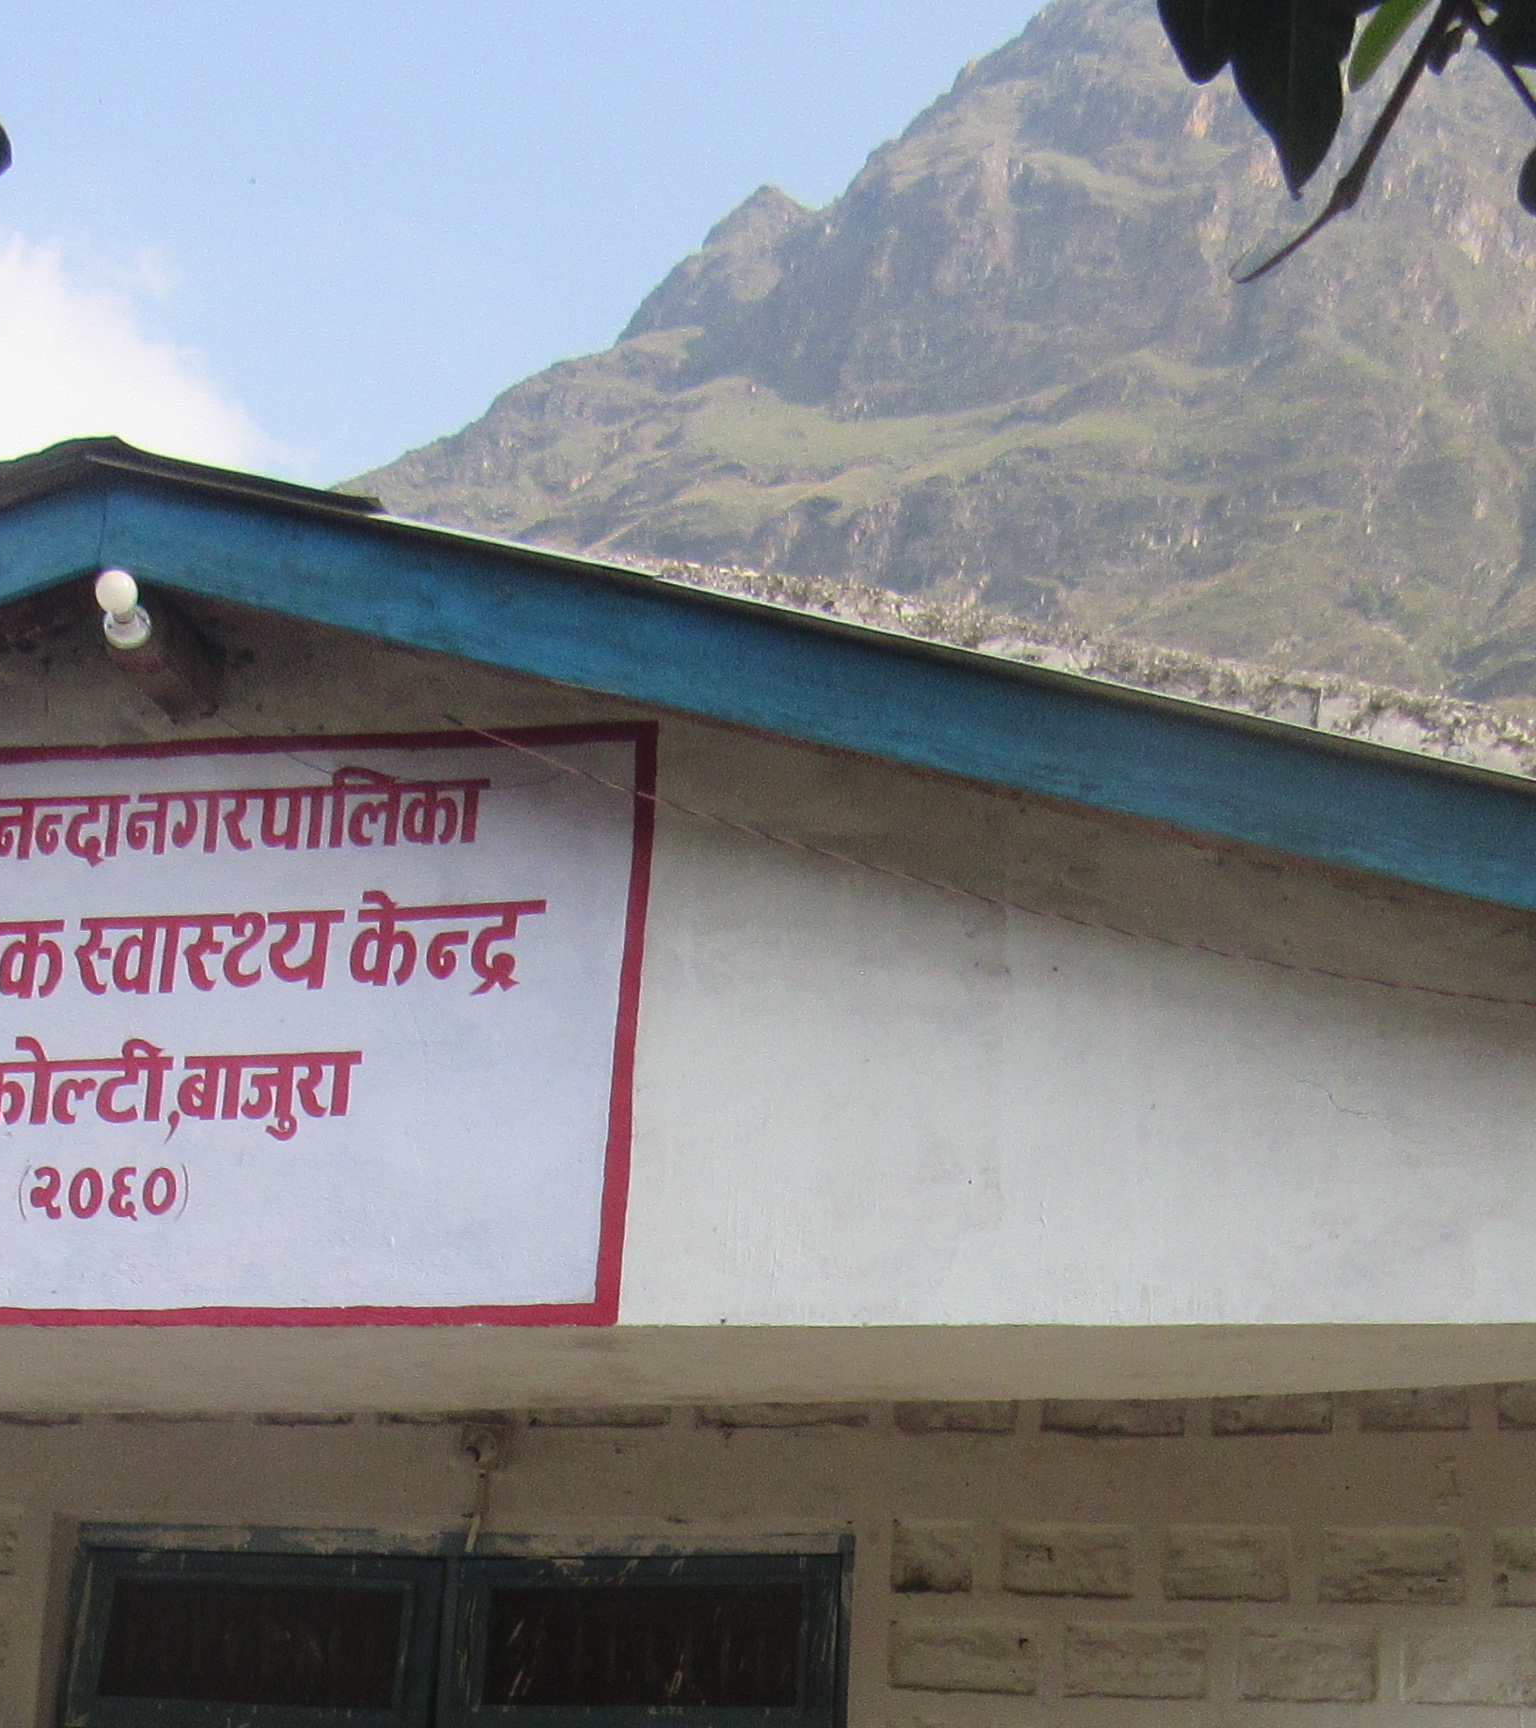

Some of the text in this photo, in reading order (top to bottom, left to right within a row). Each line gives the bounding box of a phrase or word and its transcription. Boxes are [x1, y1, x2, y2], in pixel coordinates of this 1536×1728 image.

[74, 908, 346, 995] स्वास्थ्य
[348, 890, 548, 996] केन्द्र
[17, 1160, 190, 1222] (२०६०)
